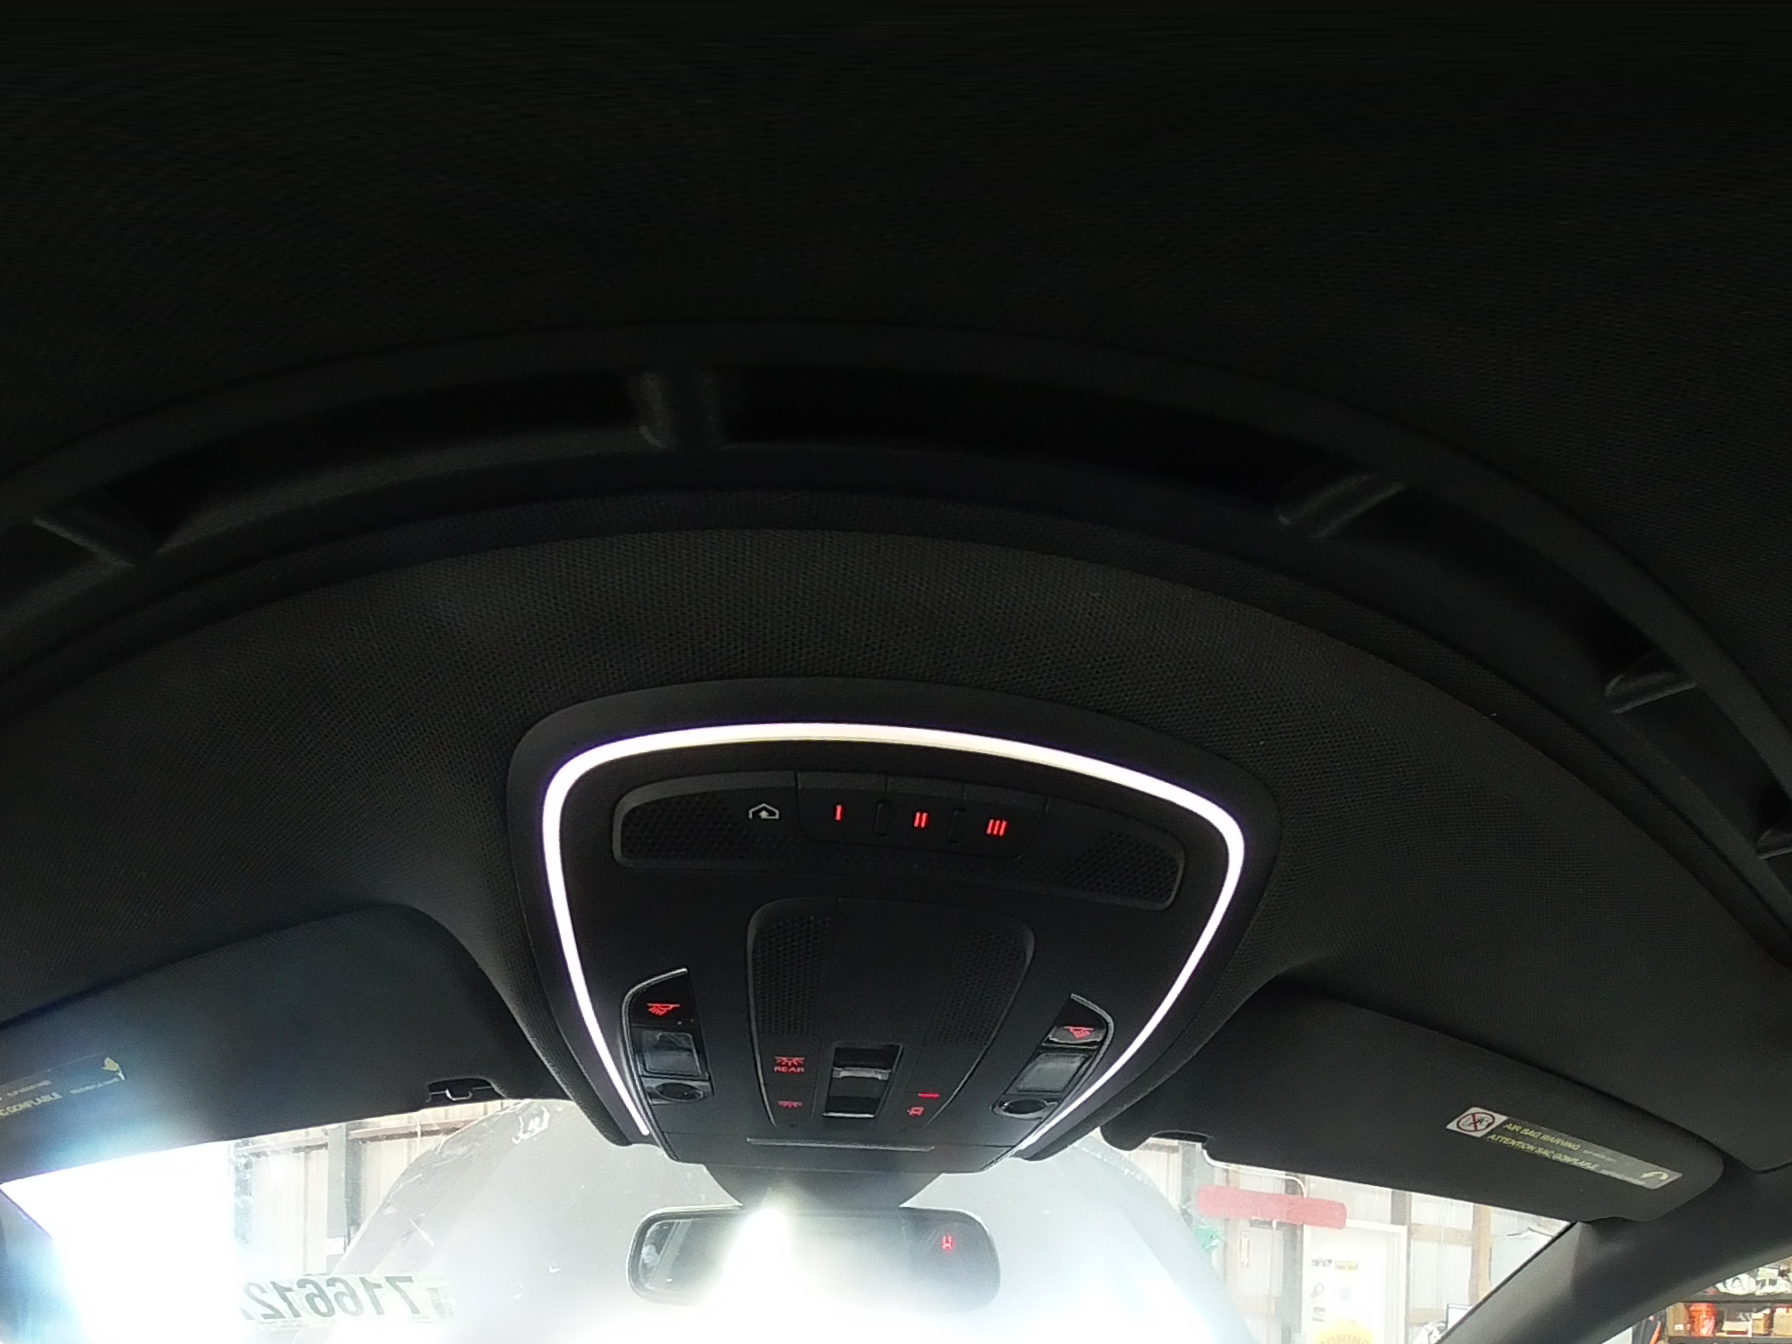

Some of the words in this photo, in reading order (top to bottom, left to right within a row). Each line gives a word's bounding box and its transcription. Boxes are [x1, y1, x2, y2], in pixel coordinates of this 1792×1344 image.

[6, 1092, 62, 1115] GONFLABLE
[1487, 1133, 1538, 1152] ATTENTION
[1519, 1127, 1541, 1139] BAG
